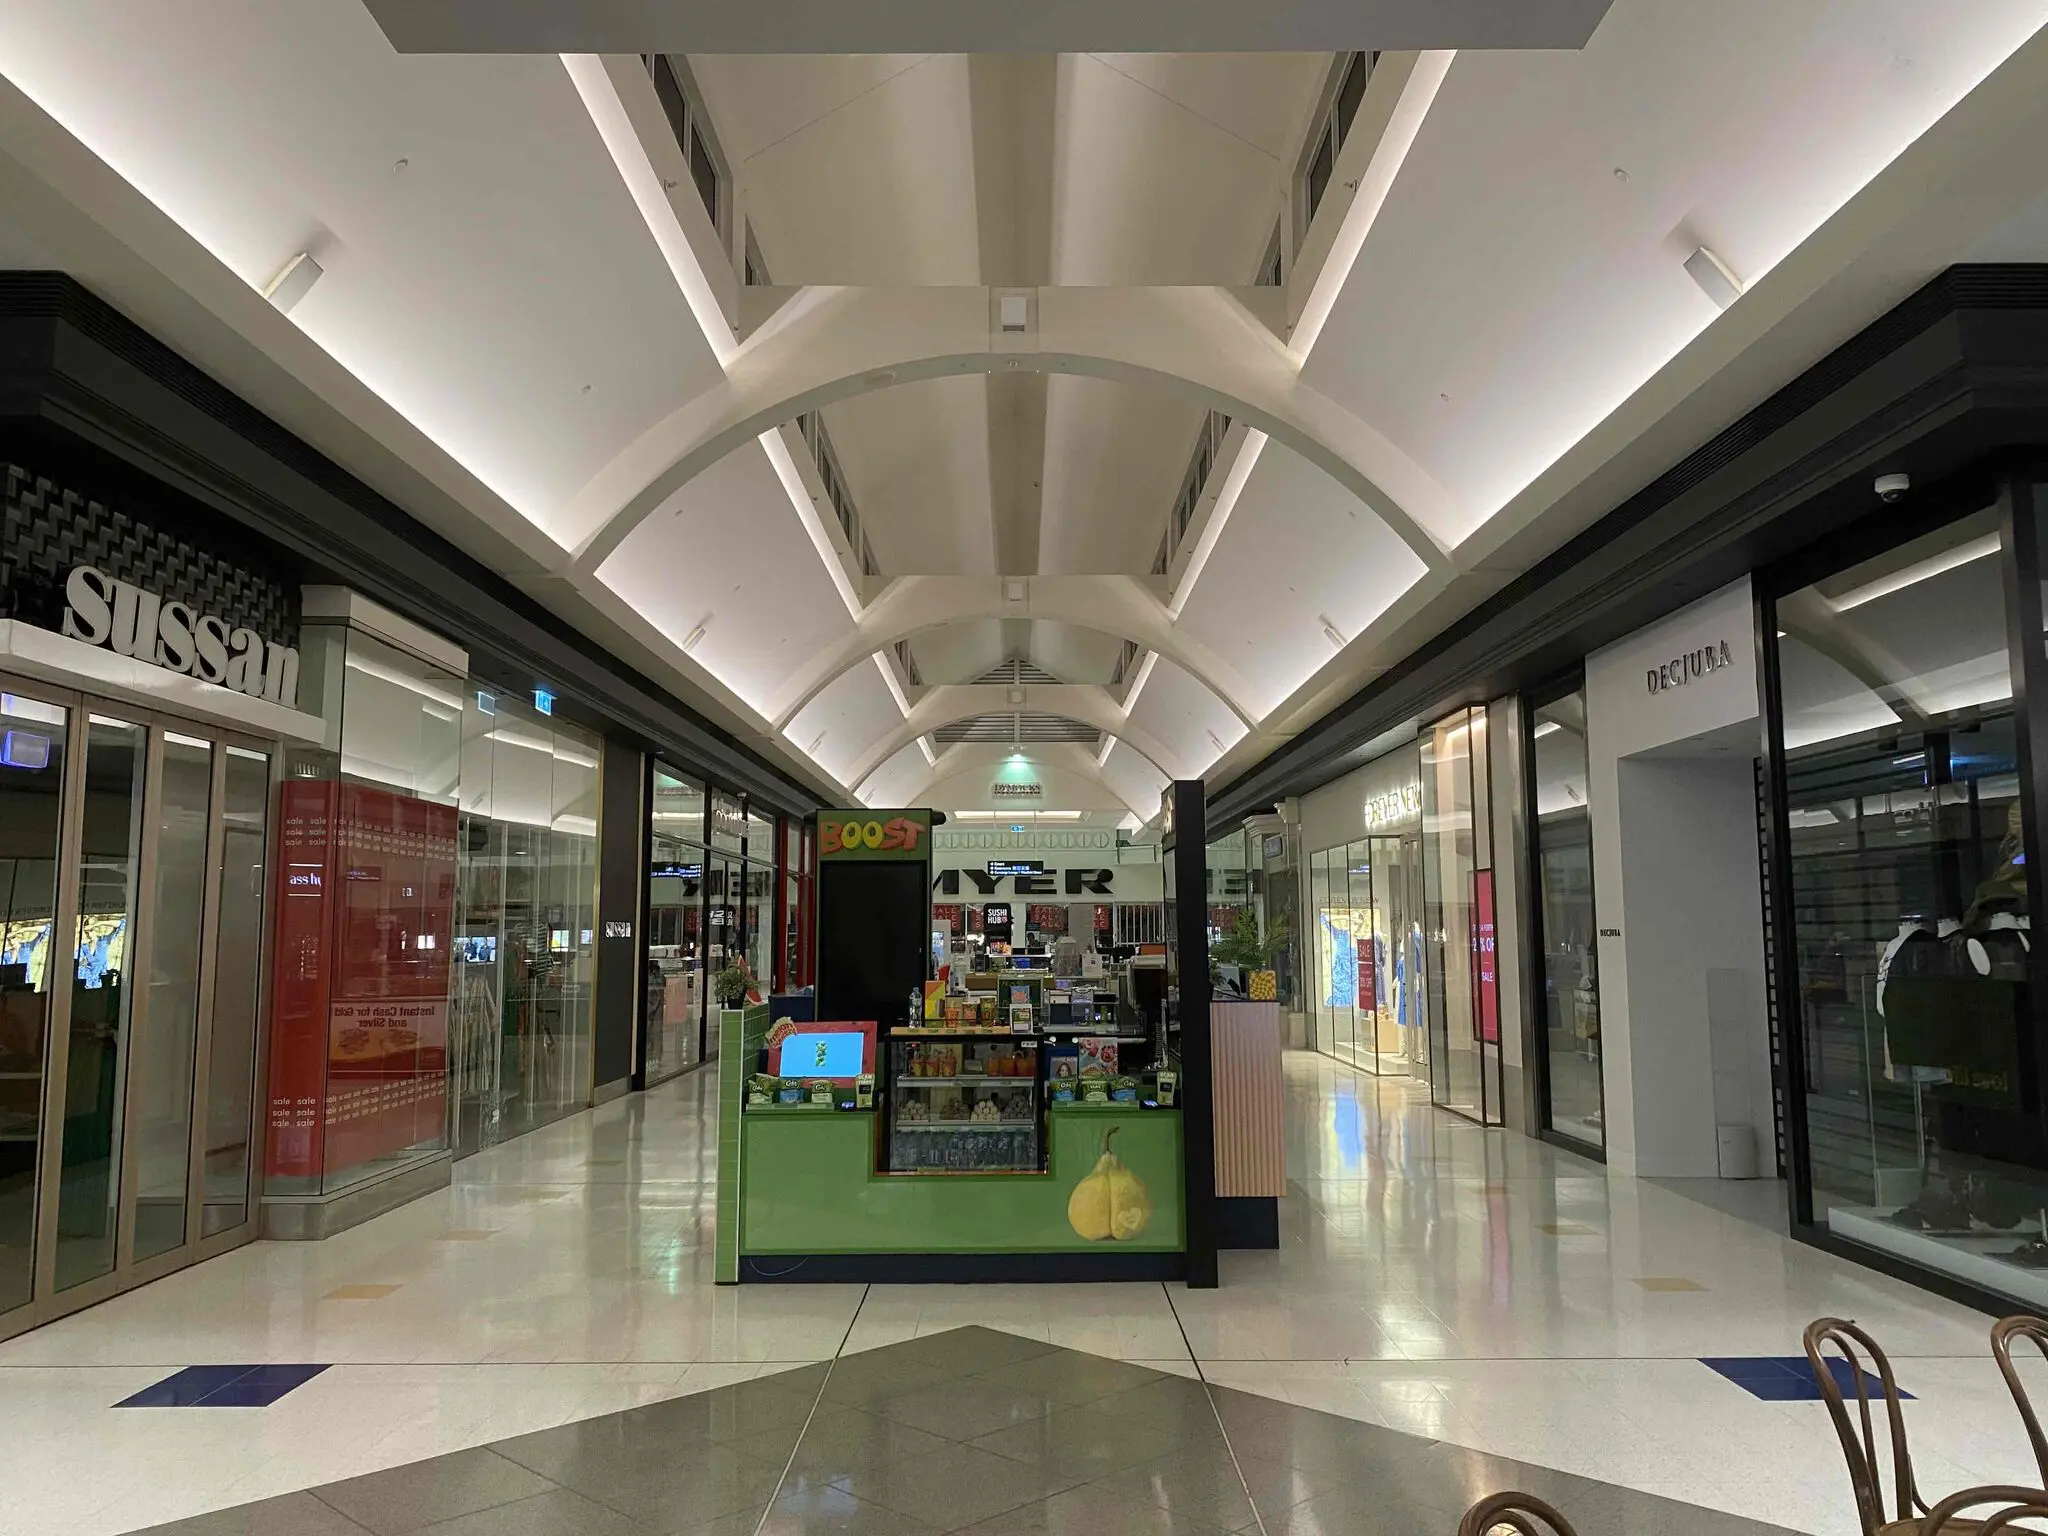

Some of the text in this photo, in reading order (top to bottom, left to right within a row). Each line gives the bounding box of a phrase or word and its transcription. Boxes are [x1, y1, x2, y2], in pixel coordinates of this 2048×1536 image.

[62, 565, 299, 709] sussan
[1647, 640, 1730, 695] DECJUBA
[820, 817, 925, 854] BOOST
[987, 908, 1007, 917] SUSHI
[987, 916, 1001, 924] HUB
[273, 1096, 316, 1105] sale sale
[272, 1108, 316, 1116] sale sale
[272, 1119, 315, 1128] sale sale
